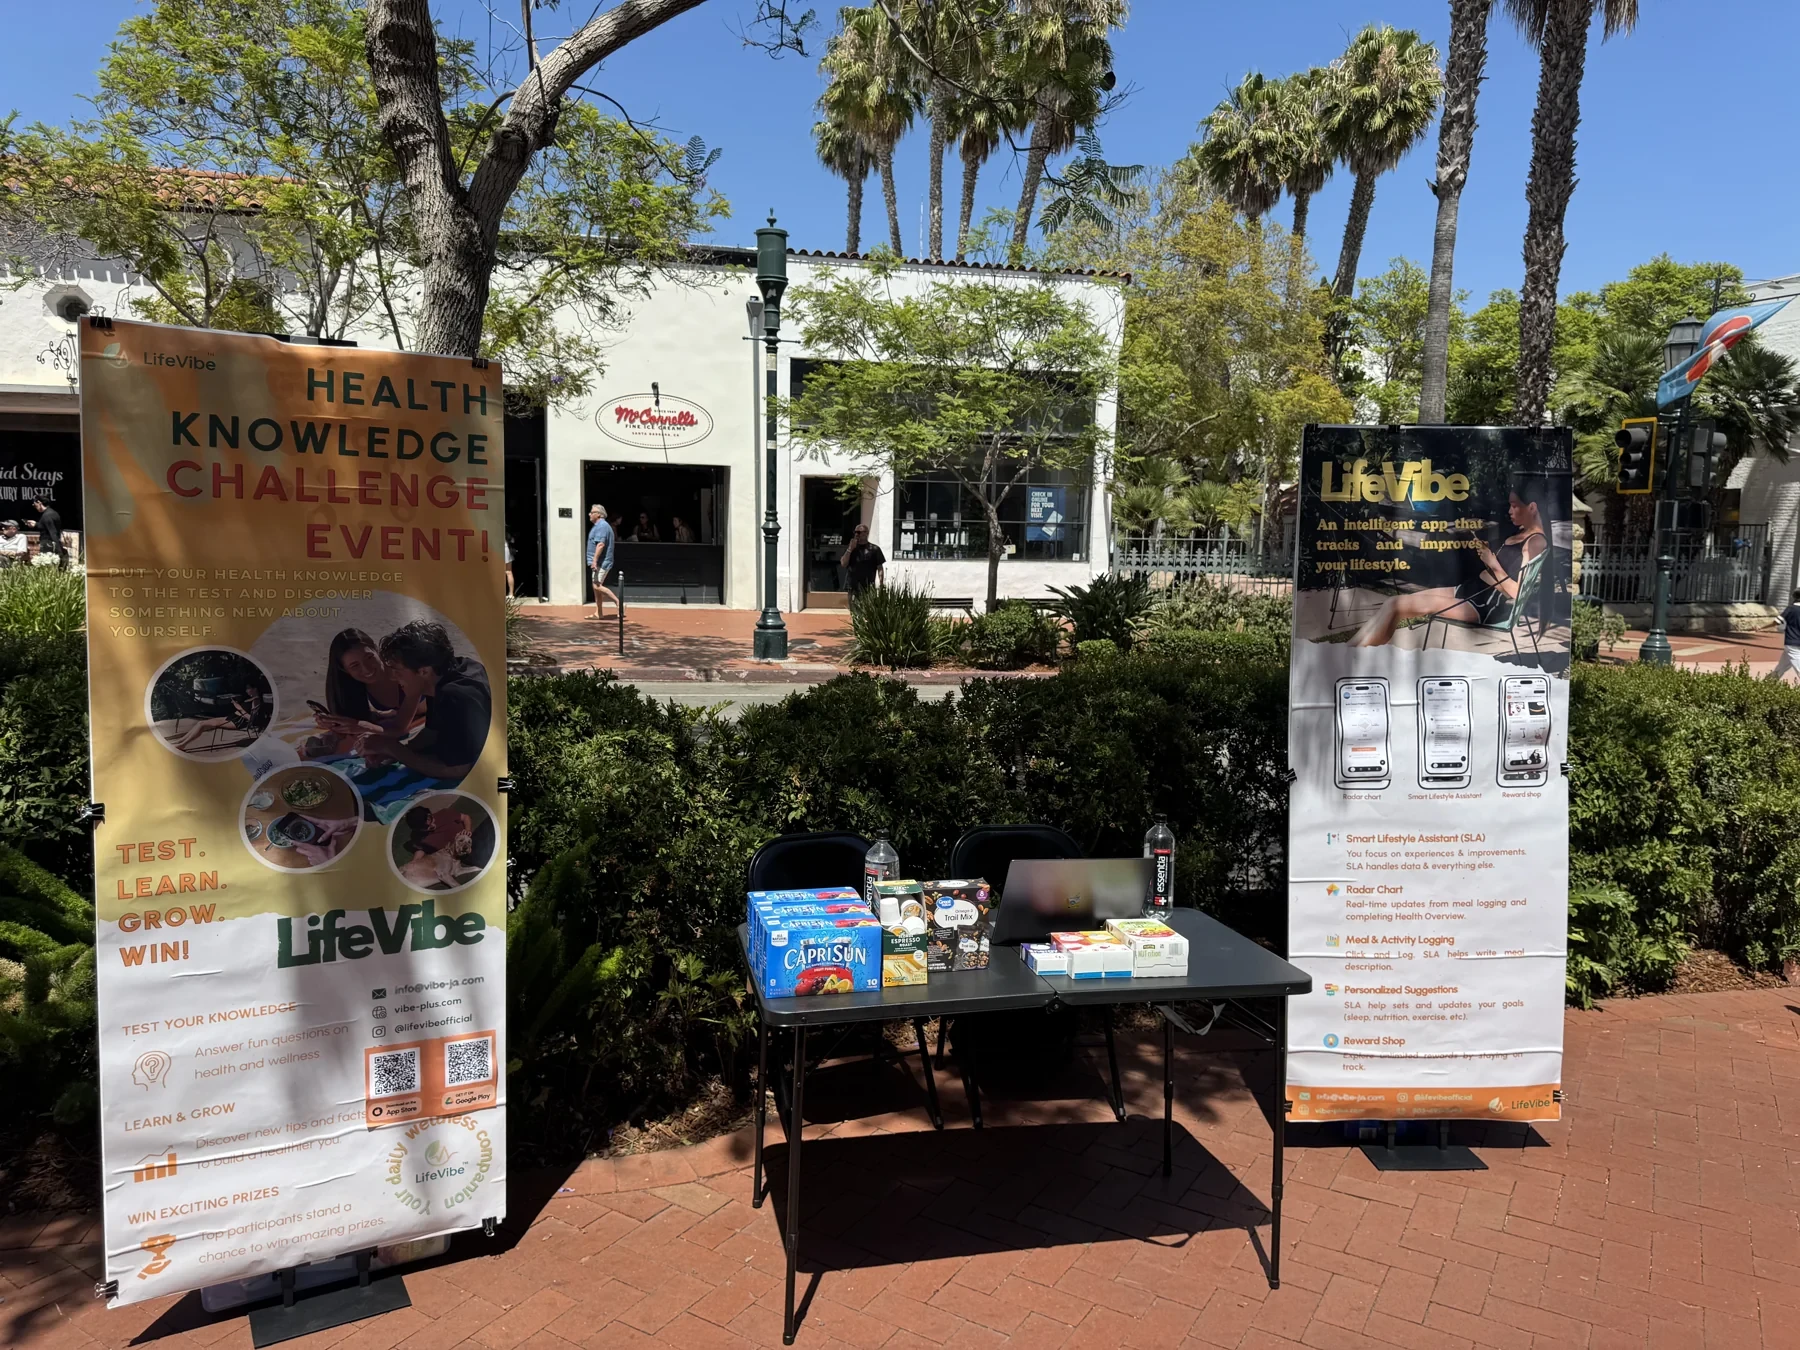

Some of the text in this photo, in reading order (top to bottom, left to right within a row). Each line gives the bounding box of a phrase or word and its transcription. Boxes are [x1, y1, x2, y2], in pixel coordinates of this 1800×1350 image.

[144, 352, 216, 371] LifeVibe
[307, 367, 488, 416] HEALTH
[172, 410, 489, 465] KNOWLEDGE
[21, 462, 64, 486] Stays
[1320, 459, 1470, 502] LifeVibe
[166, 460, 489, 510] CHALLENGE
[1317, 517, 1483, 533] An intelligent app that
[306, 523, 489, 563] EVENT!
[1316, 539, 1360, 551] tracks
[1376, 538, 1403, 550] and
[108, 568, 404, 582] PUT YOUR HEALTH KNOWLEDGE
[1316, 558, 1410, 574] your lifestyle.
[109, 587, 373, 600] TO THE TEST AND DISCOVER
[109, 606, 342, 618] SOMETHING NEW ABOUT
[110, 626, 217, 638] YOURSELF.
[1346, 834, 1486, 846] Smart Lifestyle Assistant (SLA)
[116, 837, 206, 865] TEST.
[1347, 850, 1362, 858] You
[1366, 850, 1388, 858] focus
[1404, 850, 1454, 860] experiences
[1468, 849, 1526, 858] improvements.
[1157, 856, 1166, 893] essentia
[1346, 861, 1495, 871] SLA handles data & everything else.
[117, 870, 228, 900] LEARN.
[1346, 885, 1403, 894] Radar Chart
[1346, 900, 1387, 908] Real-time
[1391, 900, 1425, 910] updates
[1429, 900, 1448, 908] from
[1477, 899, 1506, 908] logging
[1510, 898, 1527, 906] and
[118, 904, 226, 933] GROW.
[1346, 913, 1392, 922] completing
[1424, 912, 1466, 920] Overview.
[277, 898, 487, 969] LifeVibe
[1346, 936, 1455, 946] Meal & Activity Logging
[120, 940, 190, 968] WIN!
[1345, 950, 1366, 958] Click
[1398, 951, 1415, 960] Log.
[1448, 950, 1468, 958] helps
[1504, 948, 1524, 956] meal
[1345, 963, 1394, 972] description.
[1344, 985, 1458, 996] Personalized Suggestions
[395, 998, 462, 1014] vibe-plus.com
[1368, 1002, 1386, 1010] help
[1438, 1001, 1472, 1010] updates
[1478, 1002, 1496, 1010] your
[1502, 1000, 1524, 1009] goals
[122, 1001, 297, 1036] TEST YOUR KNOWLEDGE
[395, 1014, 472, 1034] @lifevibeofficial
[1344, 1014, 1371, 1022] (sleep,
[194, 1025, 349, 1058] Answer fun questions on
[1344, 1036, 1406, 1047] Reward Shop
[195, 1050, 320, 1080] health and wellness
[1511, 1099, 1550, 1110] LifeVibe
[124, 1102, 236, 1132] LEARN & GROW
[196, 1109, 366, 1149] Discover new tips and facts
[386, 1142, 408, 1185] daily
[444, 1130, 492, 1209] companion
[415, 1166, 464, 1184] LifeVibe
[128, 1186, 280, 1225] WIN EXCITING PRIZES
[394, 1188, 431, 1215] Your
[227, 1213, 303, 1236] participants
[306, 1203, 341, 1220] stand
[344, 1202, 352, 1212] a
[198, 1216, 386, 1265] chance to win amazing prizes.
